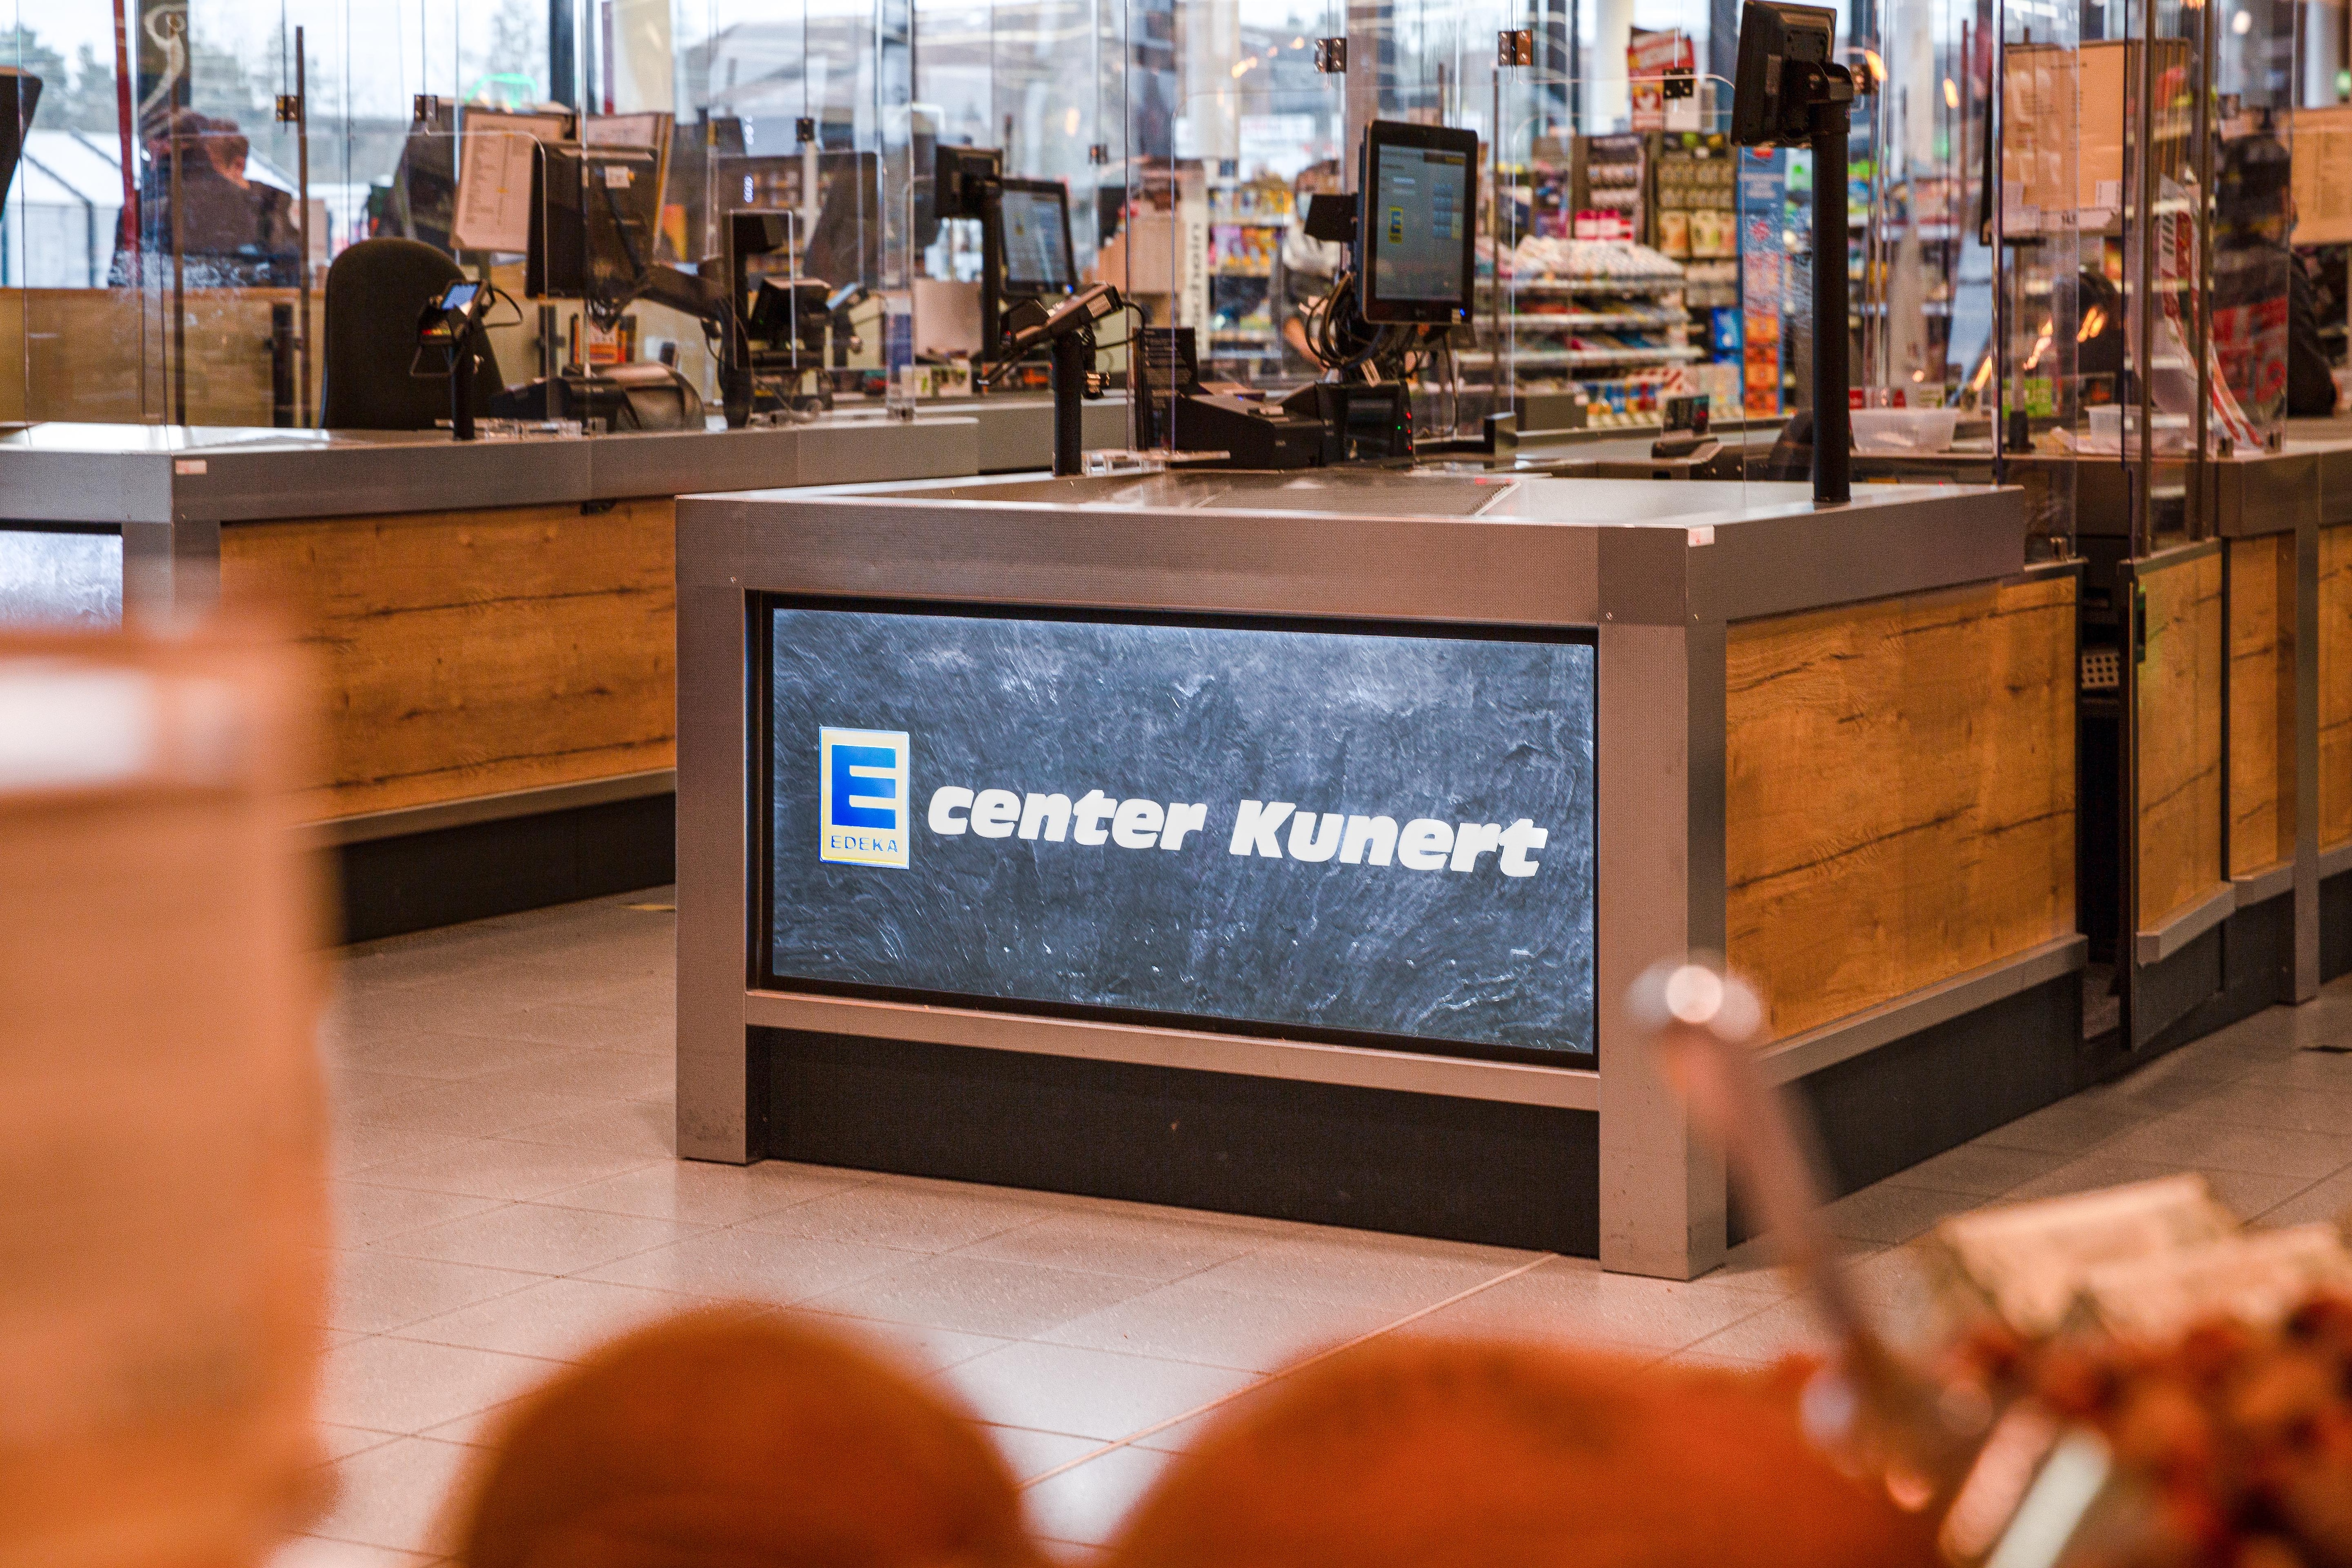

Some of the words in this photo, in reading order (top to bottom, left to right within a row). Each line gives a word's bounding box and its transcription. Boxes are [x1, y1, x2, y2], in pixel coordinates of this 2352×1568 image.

[832, 744, 896, 829] E
[830, 835, 898, 853] EDEKA
[927, 786, 1208, 850] center
[1229, 799, 1549, 877] Kunert
